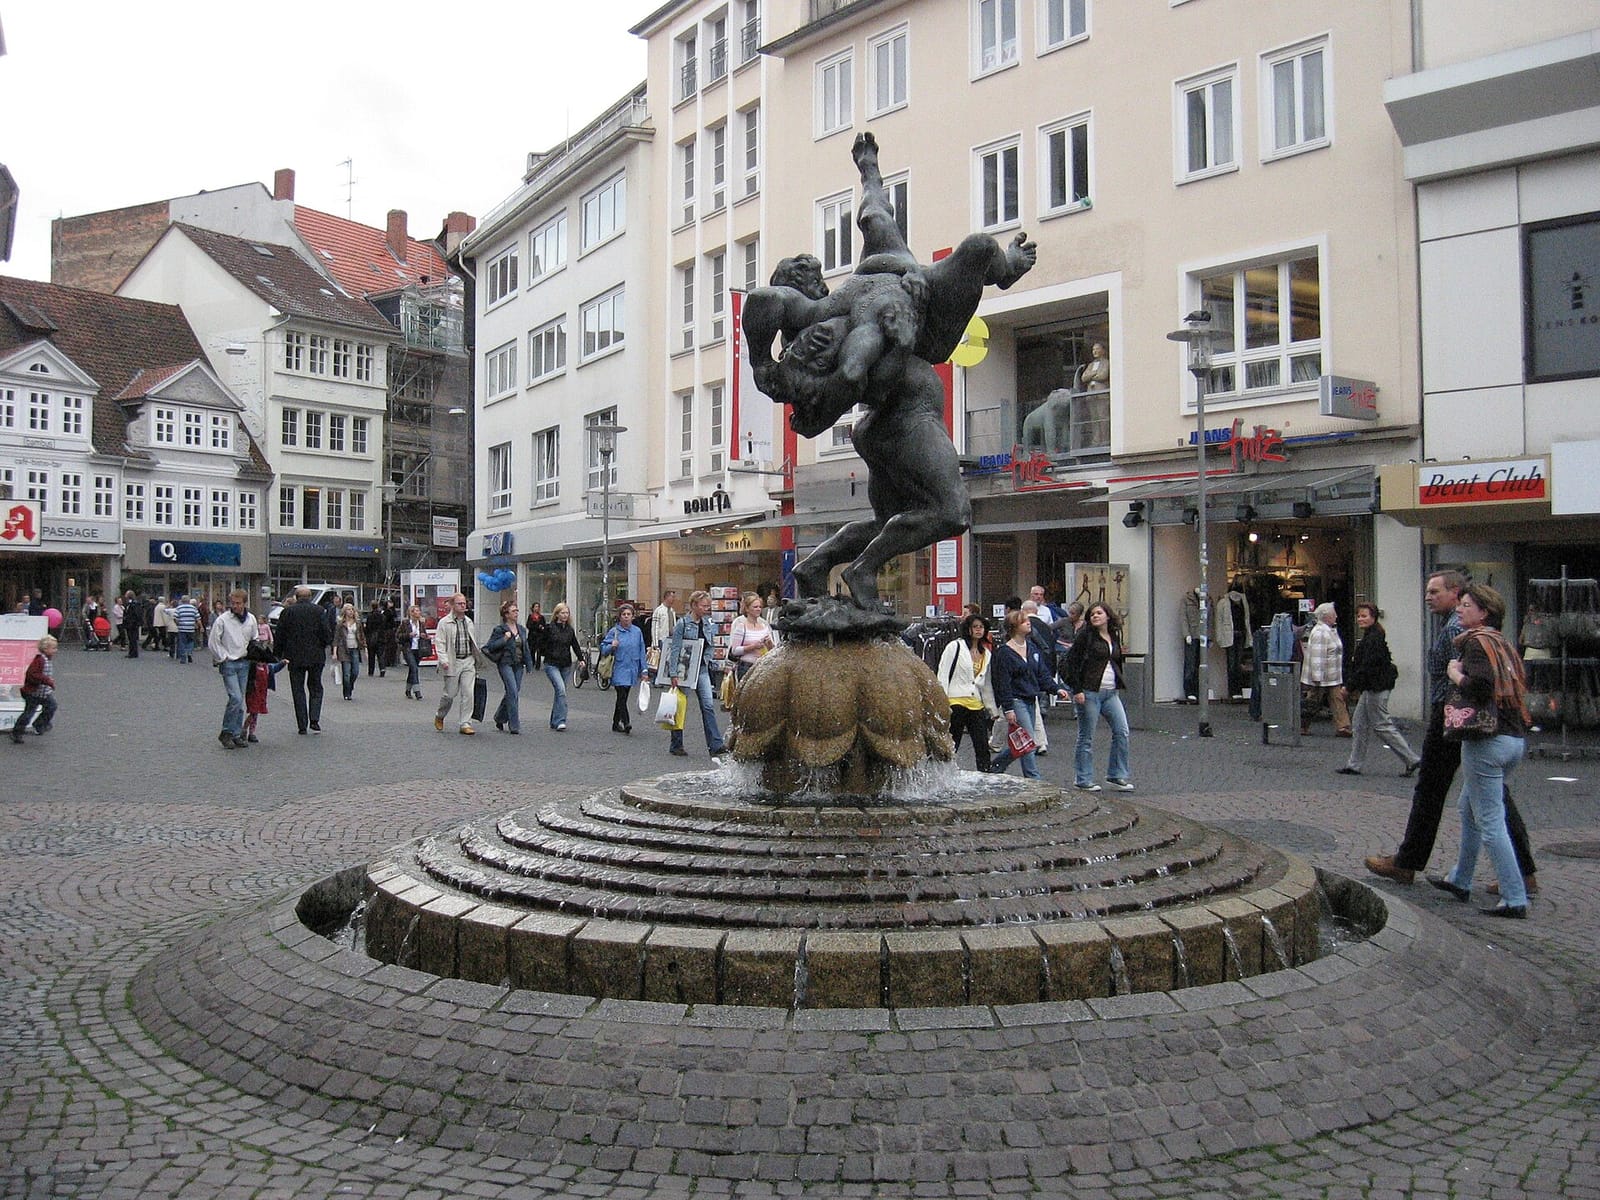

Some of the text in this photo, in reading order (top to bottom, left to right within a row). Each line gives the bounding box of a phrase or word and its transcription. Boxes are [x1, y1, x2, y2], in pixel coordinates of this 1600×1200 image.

[1189, 427, 1232, 445] JANS
[1424, 465, 1542, 498] Beat Club
[684, 483, 732, 514] BONITA
[42, 526, 99, 538] PASSAGE
[725, 534, 752, 550] BONITA
